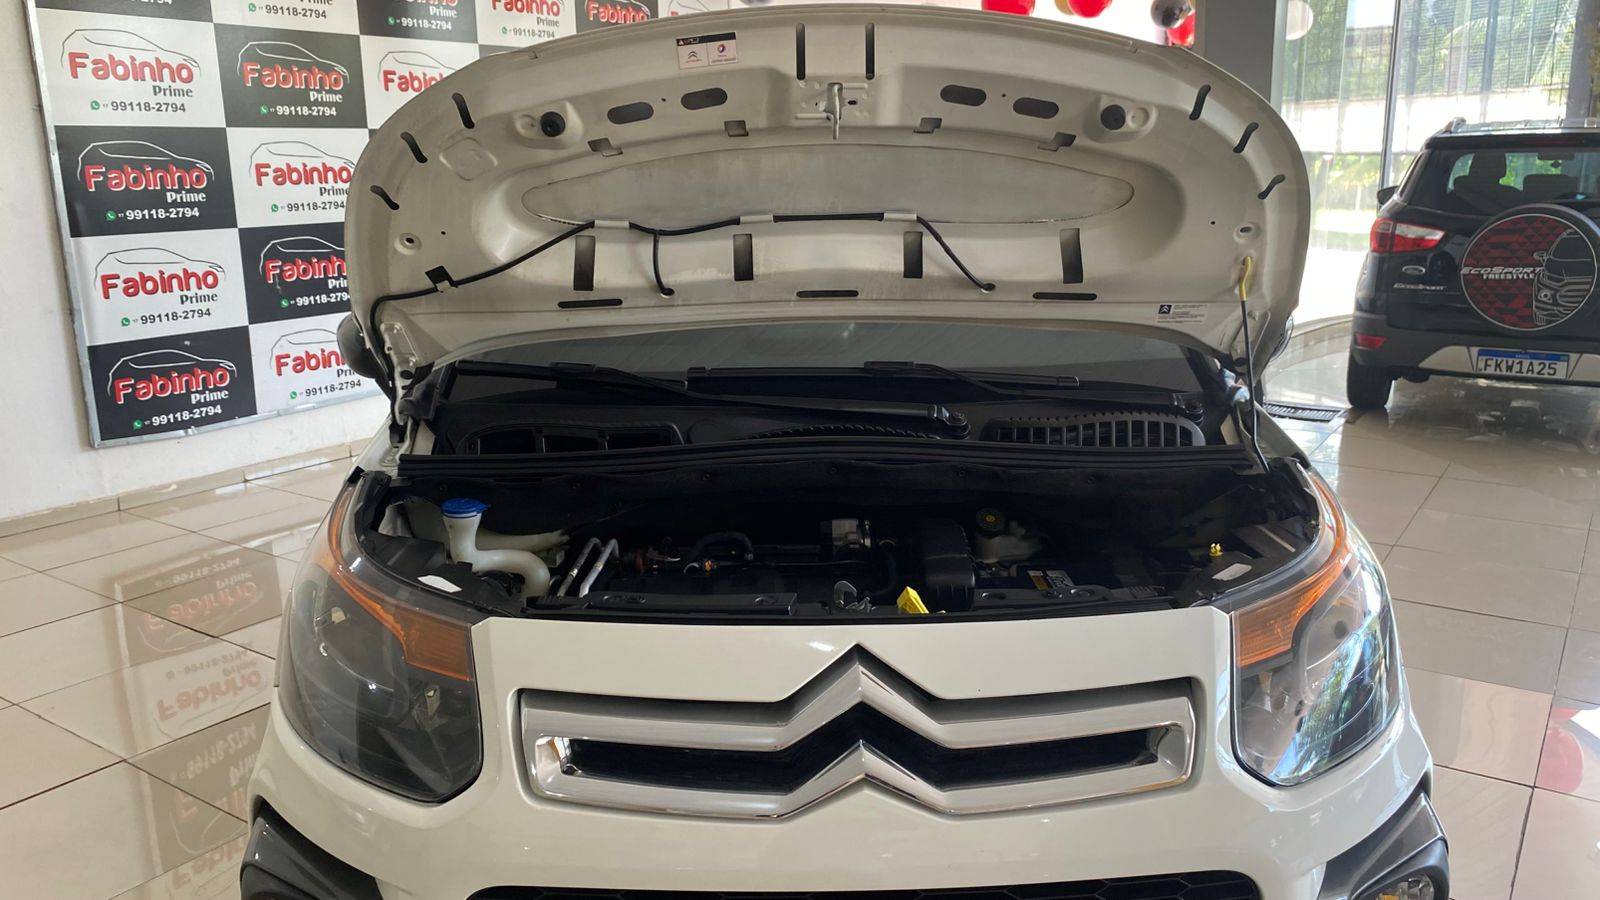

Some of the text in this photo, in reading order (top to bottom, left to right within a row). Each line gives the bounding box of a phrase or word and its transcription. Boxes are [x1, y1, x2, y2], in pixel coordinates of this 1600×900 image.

[265, 4, 327, 19] 99118-2794
[429, 6, 458, 18] Prime
[587, 1, 648, 24] Fabinho
[401, 17, 452, 30] 99118-2794
[536, 17, 560, 28] Prime
[512, 26, 555, 38] 99118-2794
[68, 51, 194, 84] Fabinho
[242, 61, 344, 90] Fabinho
[152, 85, 193, 97] Prime
[310, 91, 343, 103] Prime
[111, 101, 186, 113] 99118-2794
[276, 105, 337, 116] 99118-2794
[84, 163, 207, 192] Fabinho
[255, 162, 353, 186] Fabinho
[166, 191, 206, 203] Prime
[126, 207, 199, 220] 99118-2794
[287, 201, 345, 212] 99118-2794
[265, 255, 347, 284] Fabinh
[100, 268, 219, 299] Fabinho
[180, 292, 218, 305] Prime
[296, 292, 350, 306] 99118-279
[140, 308, 211, 324] 99118-2794
[275, 348, 346, 376] Fabin
[1483, 358, 1557, 376] FKW1A25
[113, 367, 230, 404] Fabinho
[305, 379, 361, 396] 99118-2794
[191, 390, 229, 404] Prime
[152, 405, 222, 426] 99118-2794
